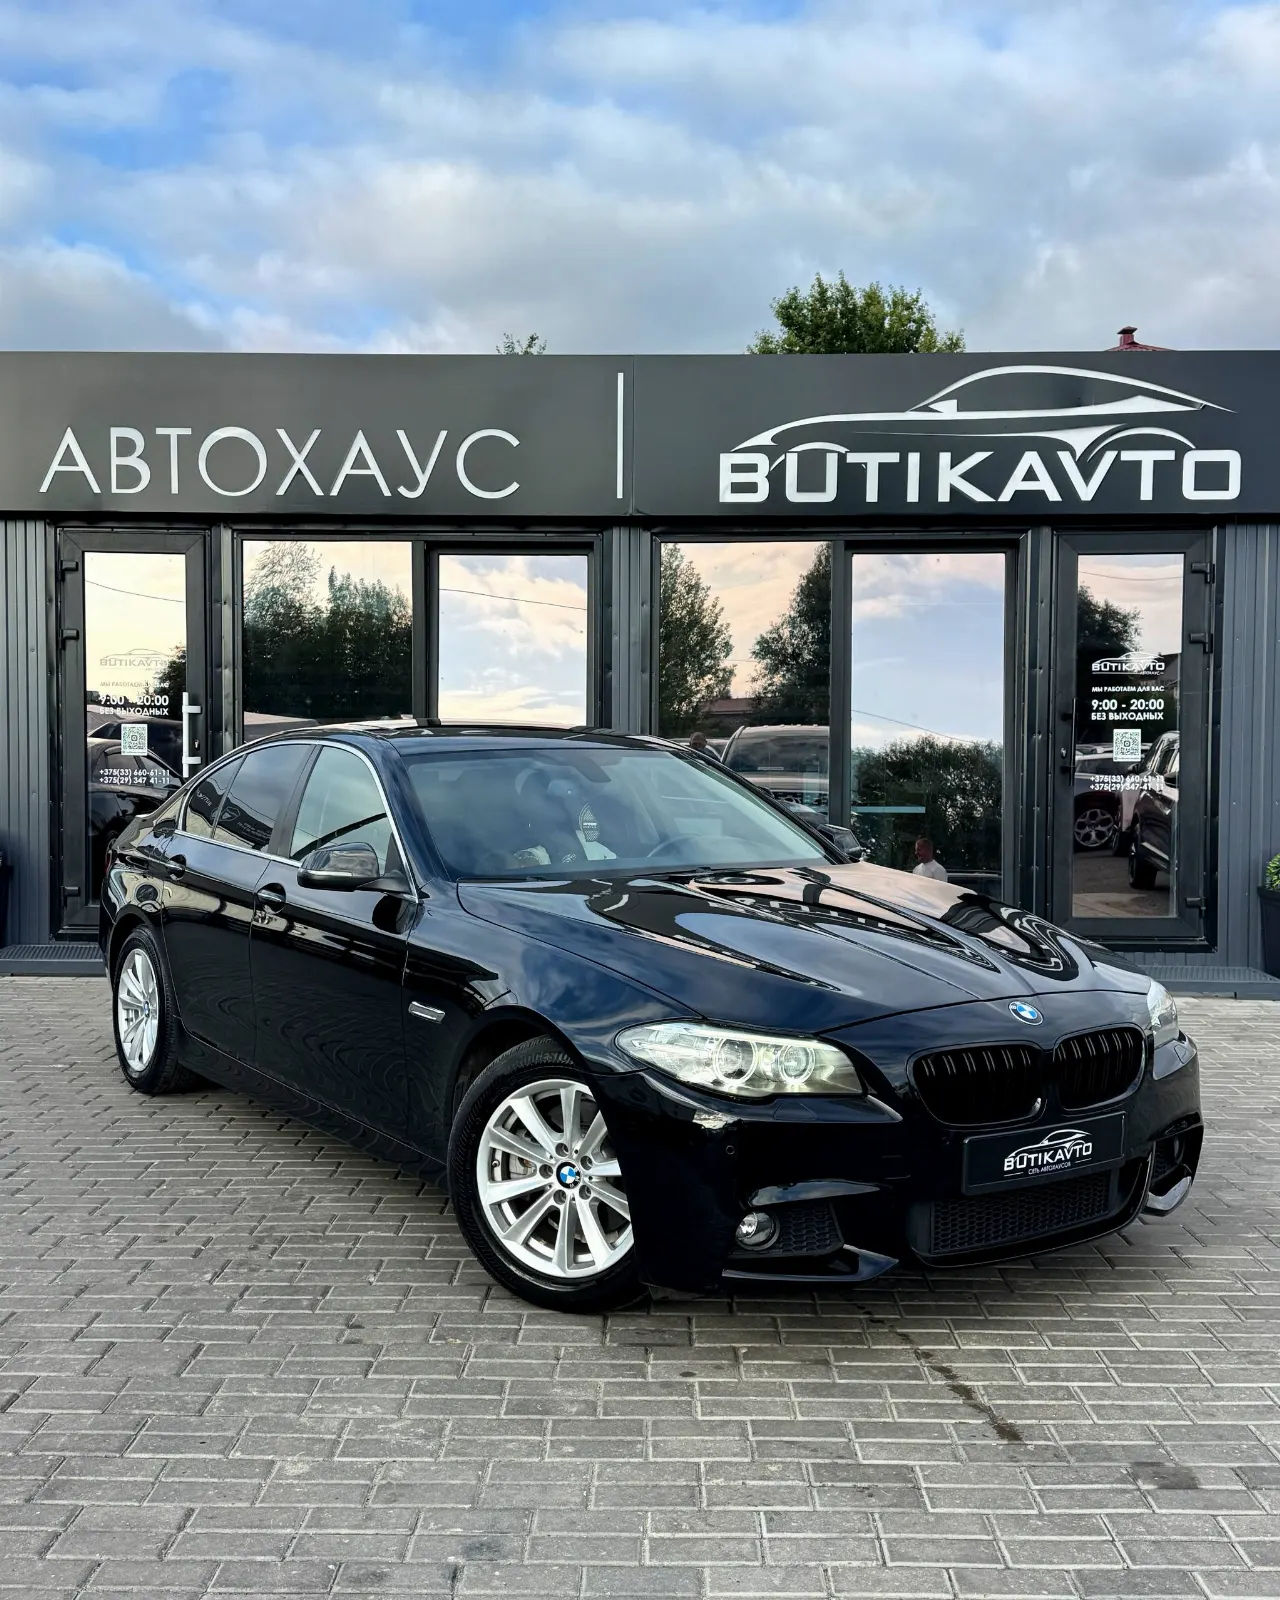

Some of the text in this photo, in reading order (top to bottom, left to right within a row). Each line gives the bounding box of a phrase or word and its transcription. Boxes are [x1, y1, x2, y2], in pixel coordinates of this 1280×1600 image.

[39, 426, 521, 499] АВТОХАУС
[719, 449, 1242, 503] BUTIKAVTO
[1091, 662, 1166, 672] BUTIKAVTO
[100, 695, 125, 705] 9:00
[136, 695, 169, 706] 20:00
[1091, 699, 1118, 711] 9:00
[1129, 699, 1165, 711] 20:00
[100, 707, 169, 717] БЕЗ ВЫХОДНЫХ
[1091, 712, 1164, 722] БЕЗ ВЫХОДНЫХ
[99, 769, 170, 777] +375(33) 660-61-11
[99, 776, 132, 786] +375(29)
[1090, 775, 1165, 784] +375(33) 660-61-11
[1090, 783, 1124, 792] +375(29)
[1003, 1142, 1093, 1171] BUTIKAVTO
